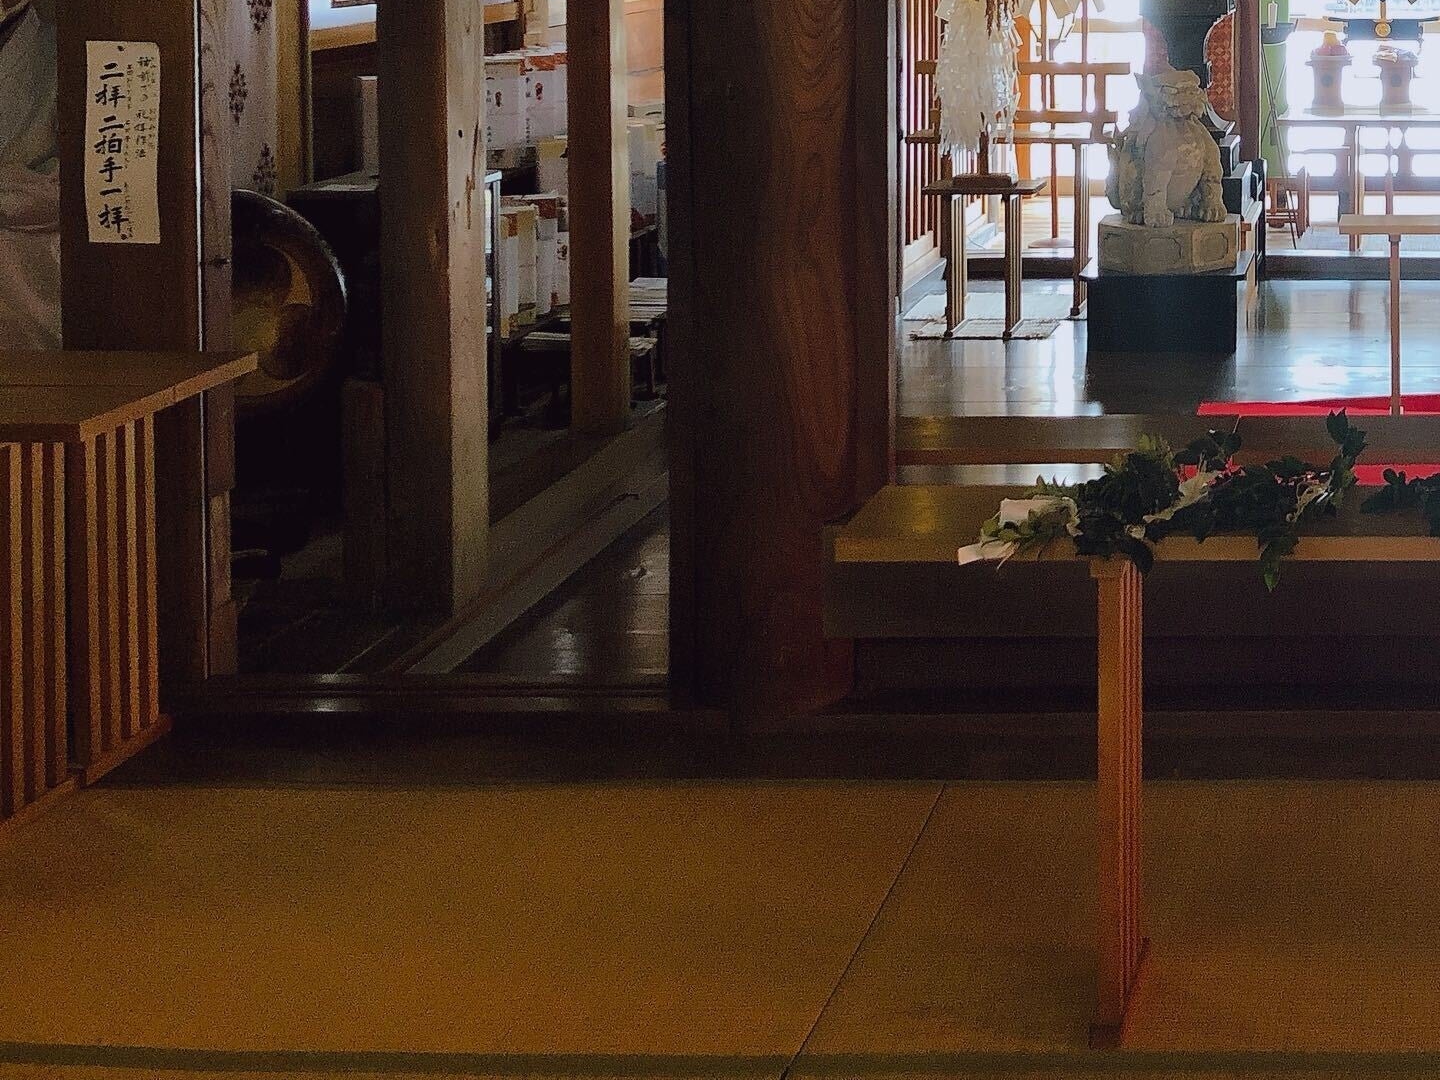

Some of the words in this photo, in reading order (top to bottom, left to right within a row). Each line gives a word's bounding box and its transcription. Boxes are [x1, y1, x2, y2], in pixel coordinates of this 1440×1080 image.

[94, 62, 129, 234] 二拝二拍手一拝
